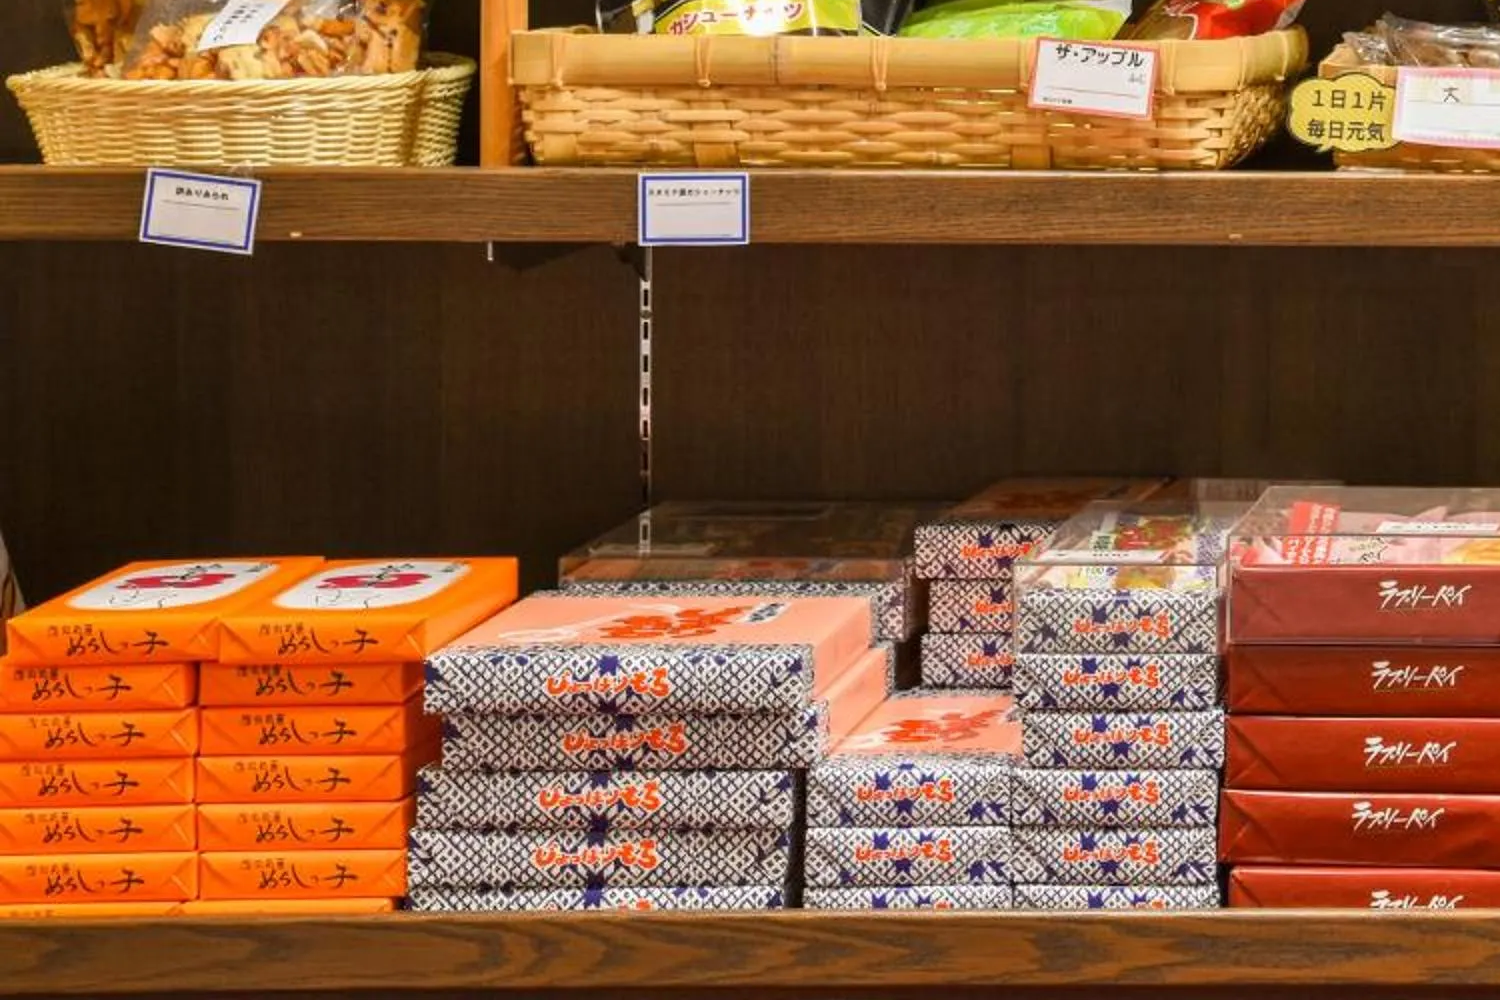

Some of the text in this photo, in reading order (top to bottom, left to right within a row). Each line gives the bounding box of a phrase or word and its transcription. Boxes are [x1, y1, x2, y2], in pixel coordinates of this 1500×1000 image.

[1056, 43, 1145, 68] ザ・アップル
[1307, 119, 1386, 143] 毎日元気
